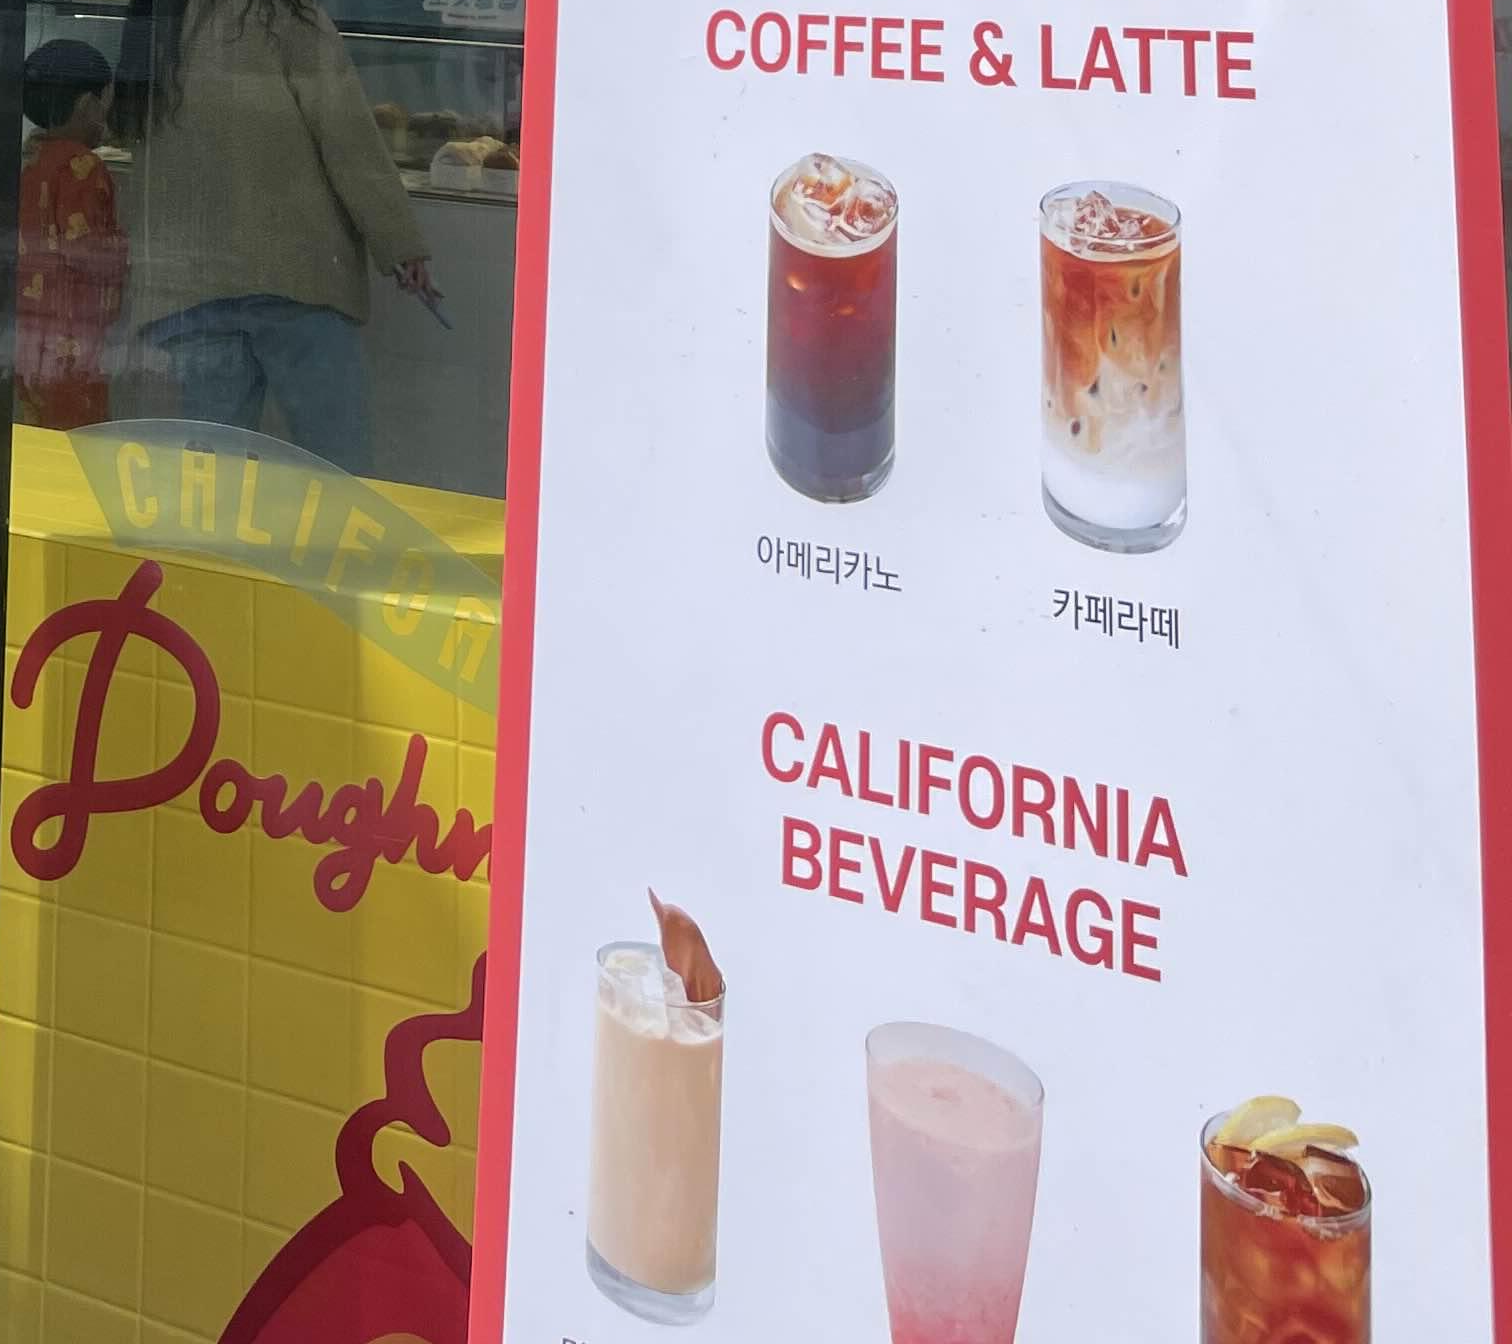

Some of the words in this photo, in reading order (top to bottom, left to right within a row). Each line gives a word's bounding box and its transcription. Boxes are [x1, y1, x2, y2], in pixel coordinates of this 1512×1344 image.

[705, 8, 946, 84] COFFEE
[968, 19, 1017, 89] &
[1039, 22, 1258, 100] LATTE
[115, 439, 494, 684] CALIFOR
[755, 534, 903, 593] 아메리카노
[1050, 586, 1182, 650] 카페라떼
[10, 560, 493, 912] Doughn
[761, 711, 1189, 878] CALIFORNIA
[781, 815, 1163, 984] BEVERAGE
